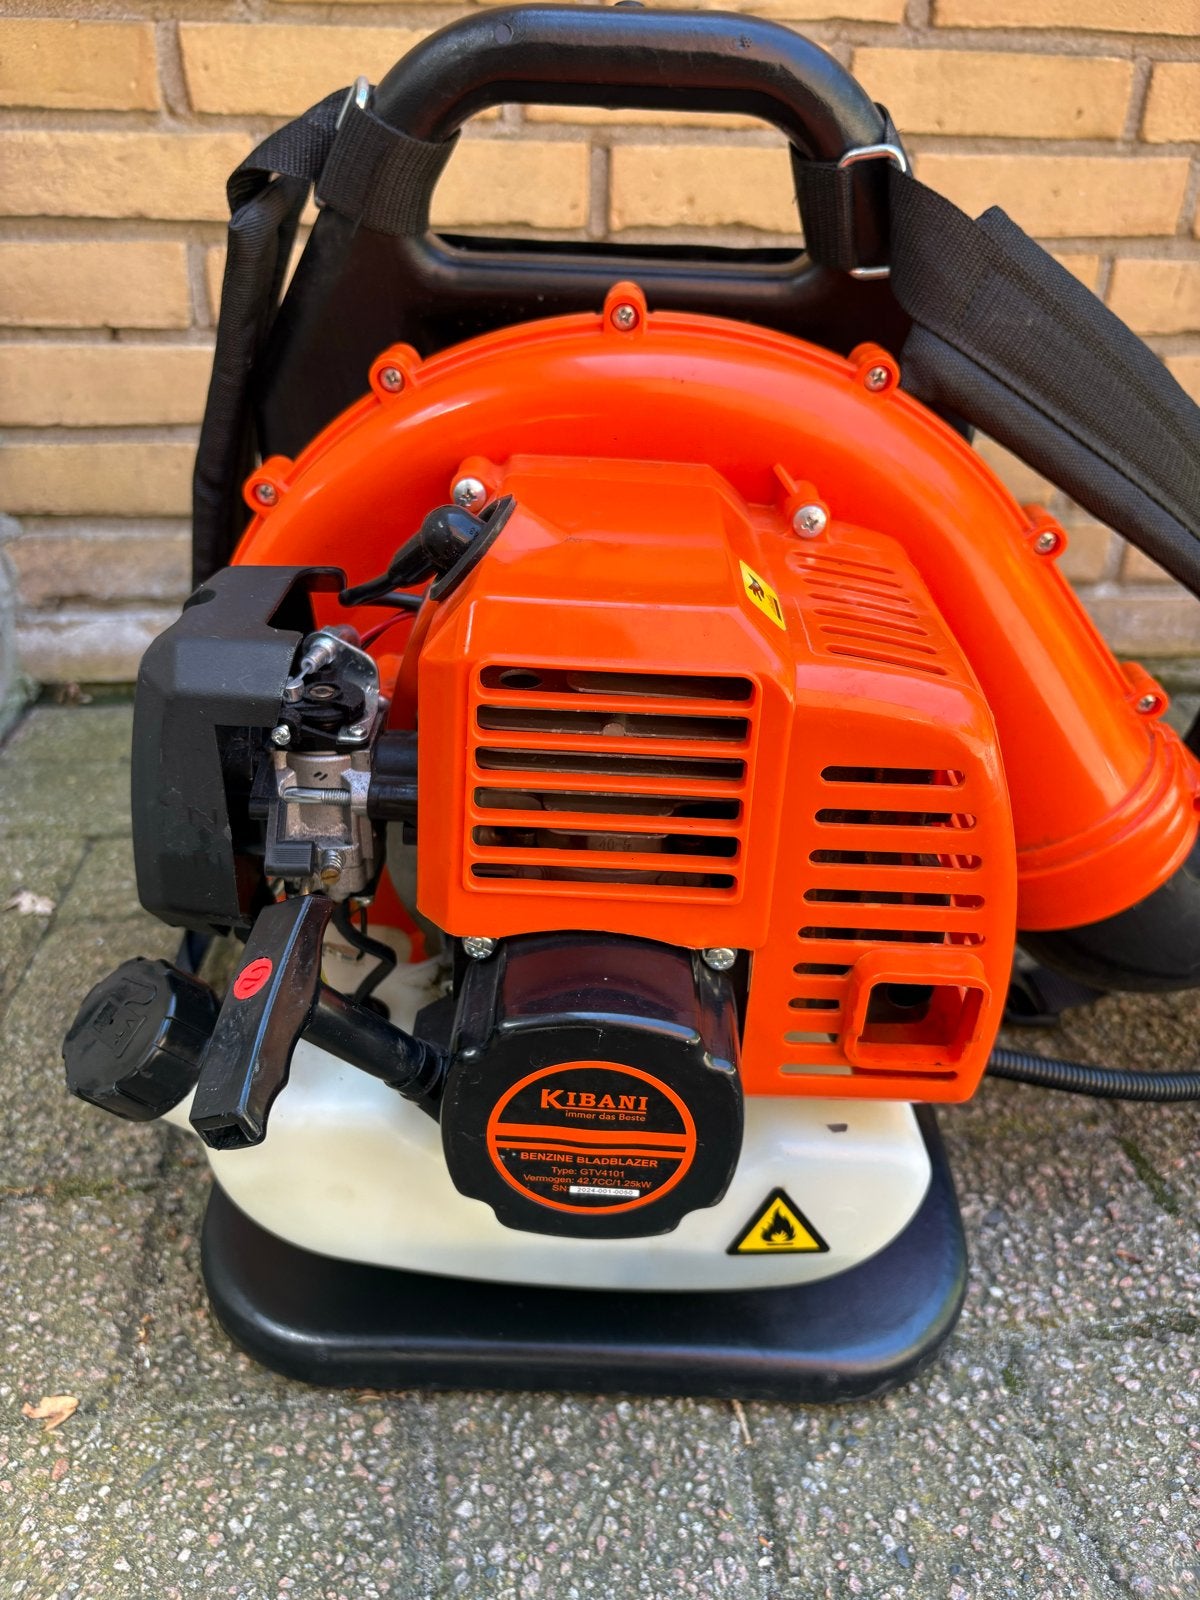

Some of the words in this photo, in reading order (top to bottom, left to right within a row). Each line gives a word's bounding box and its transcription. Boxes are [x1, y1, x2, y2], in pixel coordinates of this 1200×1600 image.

[541, 1088, 649, 1111] KIBANI
[565, 1110, 596, 1119] immer
[599, 1112, 616, 1121] das
[619, 1113, 646, 1122] Beste
[520, 1152, 573, 1163] BENZINE
[576, 1156, 658, 1168] BLADBLAZER
[552, 1166, 577, 1176] Type:
[580, 1169, 625, 1177] GTV4101
[523, 1174, 574, 1185] Vermogen:
[577, 1176, 652, 1188] 42.7CC/1.25kW
